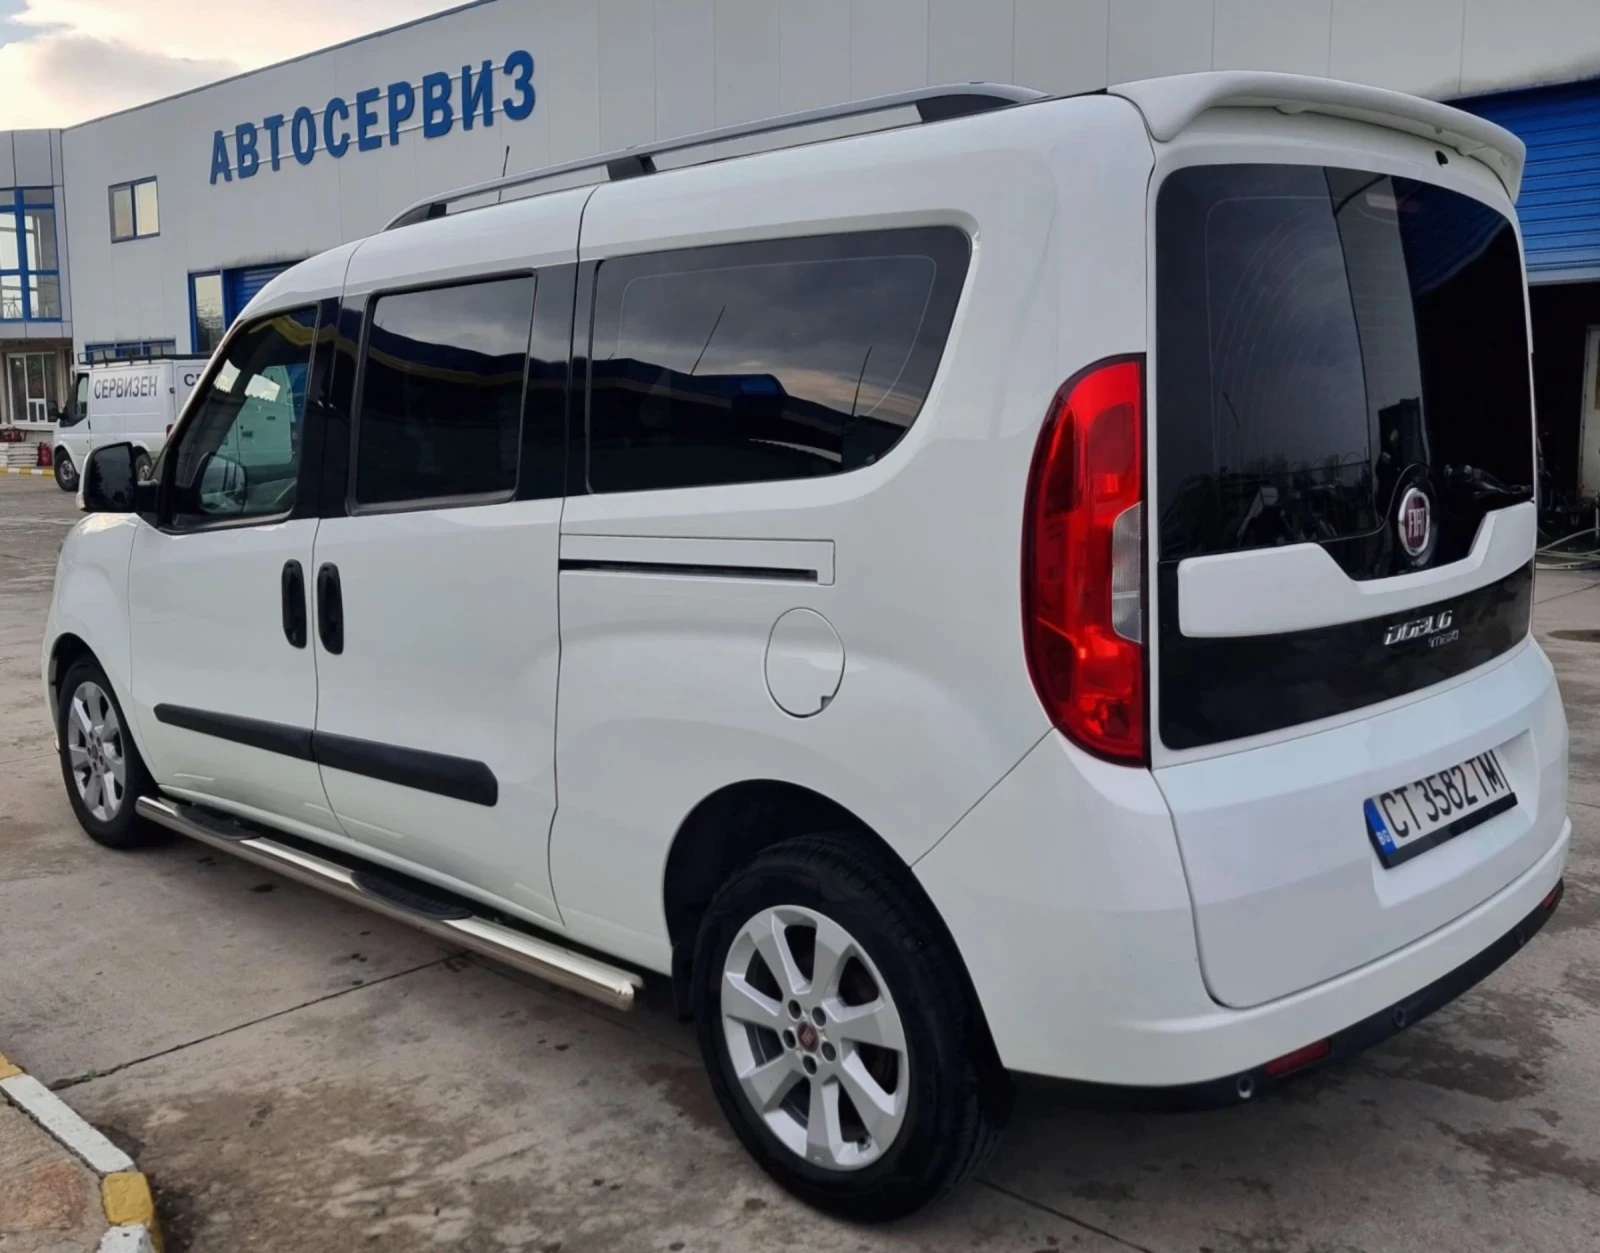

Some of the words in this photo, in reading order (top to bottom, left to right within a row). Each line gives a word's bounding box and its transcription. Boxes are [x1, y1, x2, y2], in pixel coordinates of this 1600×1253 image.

[209, 50, 536, 185] АВТОСЕРВИЗ
[94, 375, 158, 400] СЕРВИЗЕН
[1407, 508, 1426, 538] FIAT
[1412, 765, 1479, 822] 3582
